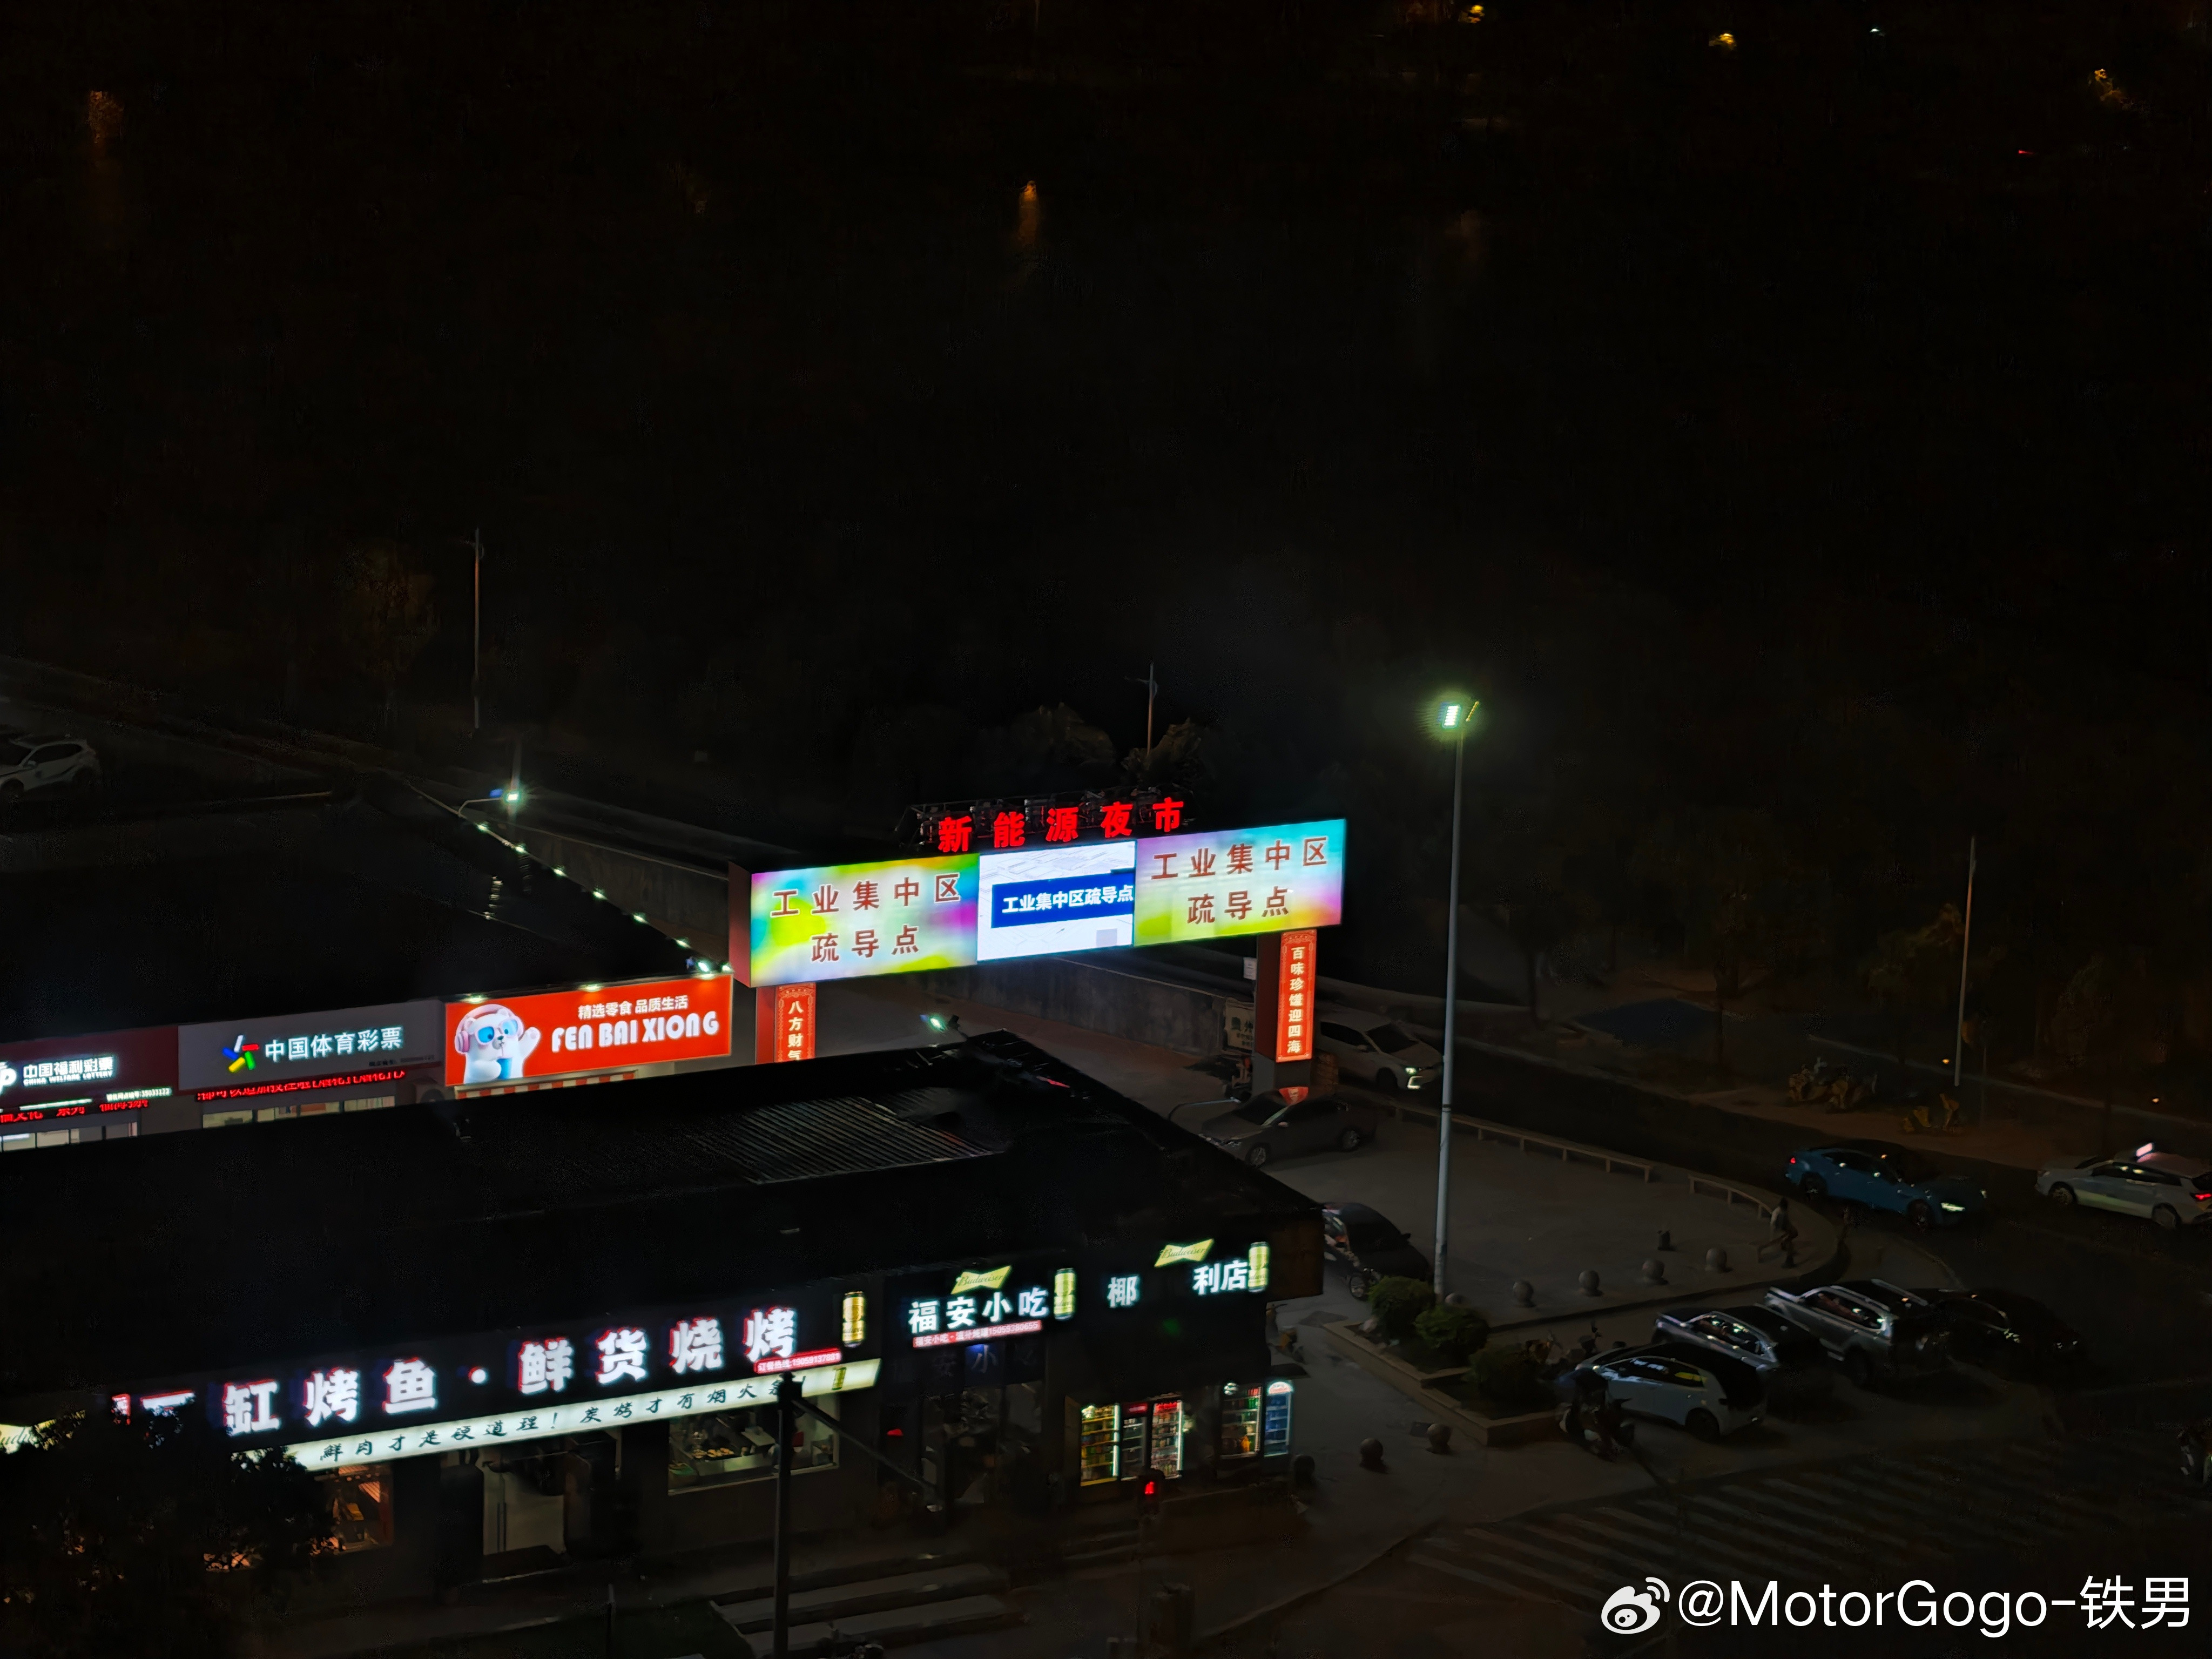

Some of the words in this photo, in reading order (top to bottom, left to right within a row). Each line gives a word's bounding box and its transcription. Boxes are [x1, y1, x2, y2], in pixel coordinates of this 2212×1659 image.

[938, 796, 1185, 853] 新能源夜市
[1151, 837, 1327, 880] 工业集中区
[771, 873, 960, 918] 工业集中区
[1002, 884, 1134, 914] 工业集中区疏导点
[1186, 886, 1290, 925] 疏导点
[811, 924, 920, 963] 疏导点
[578, 1000, 632, 1021] 精选零食
[635, 995, 689, 1014] 品质生活
[265, 1026, 403, 1062] 中国体育彩票
[551, 1024, 593, 1053] FEN
[598, 1020, 638, 1048] BAI
[642, 1010, 719, 1043] XIONG
[23, 1056, 113, 1078] 中国福利彩票
[1159, 1246, 1205, 1259] Budweiser
[958, 1273, 1004, 1286] Budweiser
[1107, 1275, 1139, 1307] 椰
[1192, 1260, 1248, 1295] 利店
[908, 1287, 1048, 1334] 福安小吃
[139, 1307, 798, 1441] 缸烤鱼·鲜货烧烤
